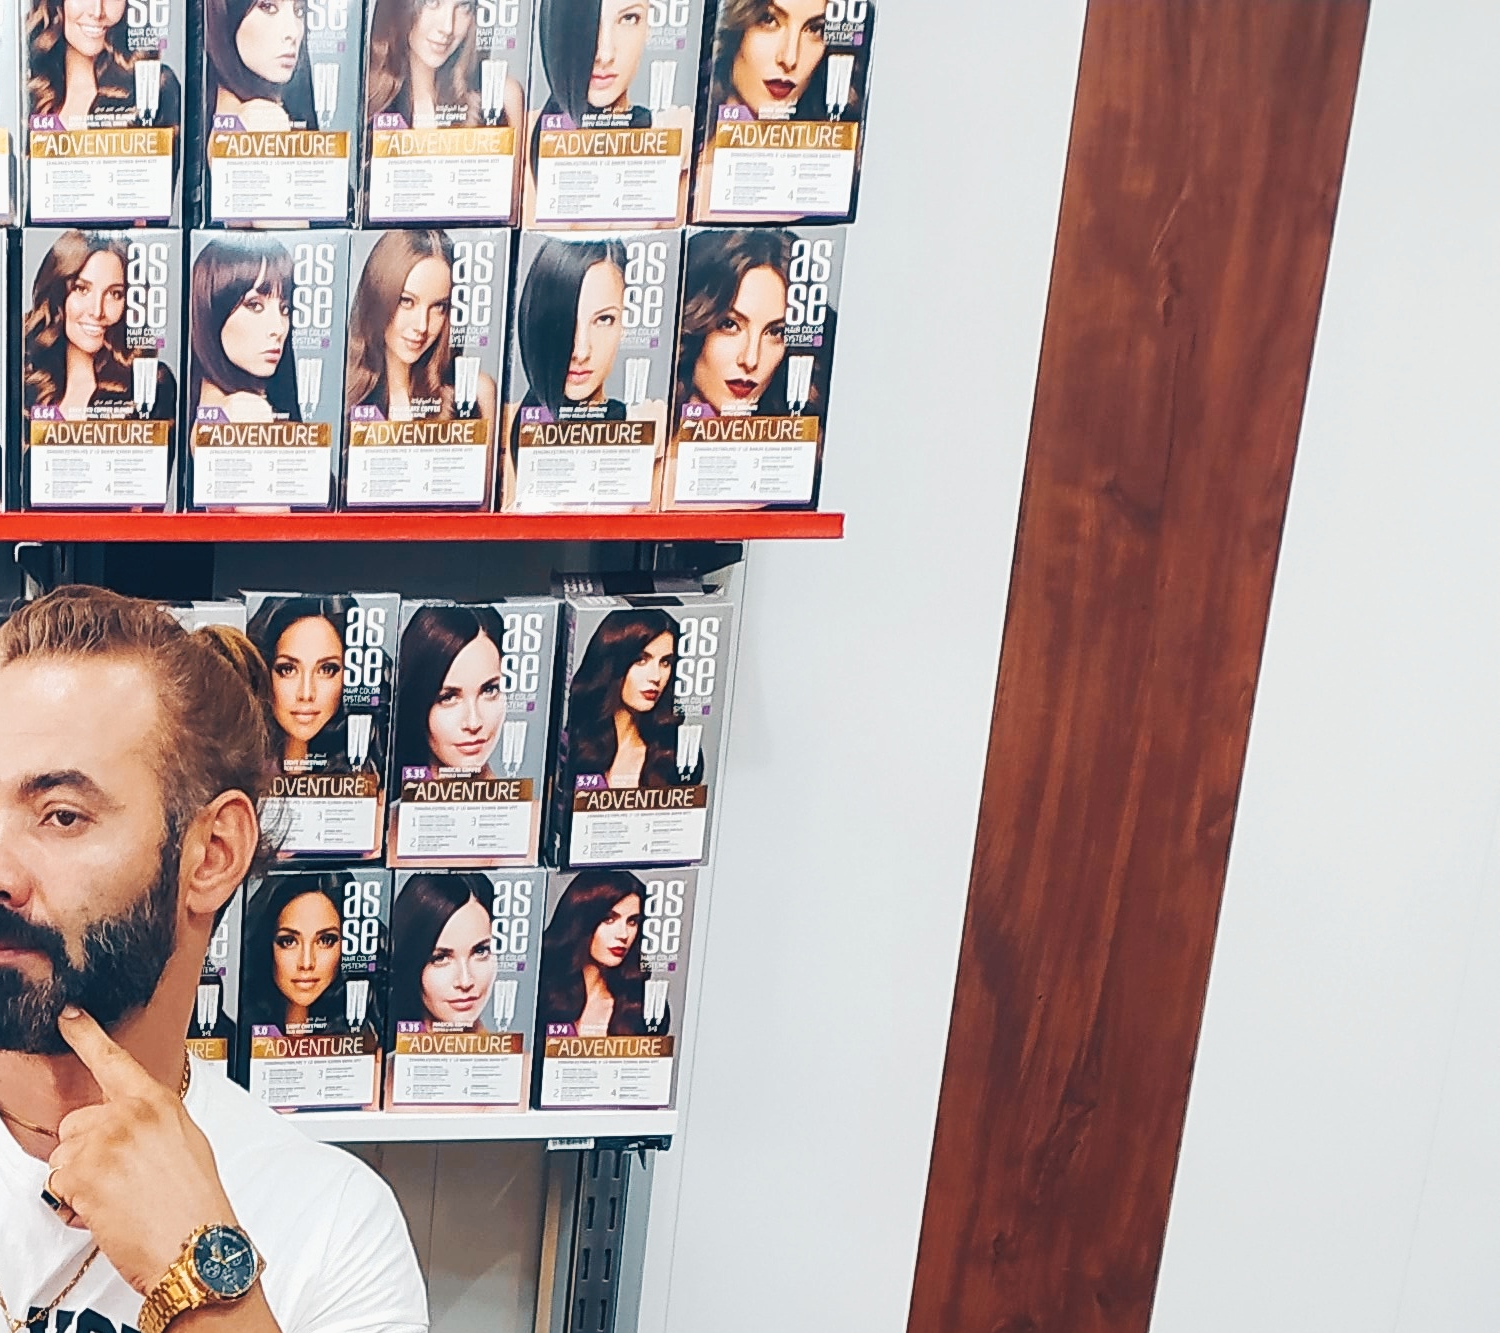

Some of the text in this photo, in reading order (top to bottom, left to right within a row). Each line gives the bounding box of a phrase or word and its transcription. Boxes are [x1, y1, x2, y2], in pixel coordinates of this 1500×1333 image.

[227, 132, 337, 157] ADVENTURE
[558, 131, 668, 156] ADVENTURE
[731, 125, 846, 149] ADVENTURE
[43, 421, 154, 444] ADVENTURE
[366, 422, 474, 445] ADVENTURE
[692, 419, 804, 443] ADVENTURE
[416, 779, 520, 801] ADVENTURE
[584, 785, 695, 809] ADVENTURE
[409, 1032, 513, 1053] ADVENTURE
[557, 1035, 660, 1056] ADVENTURE
